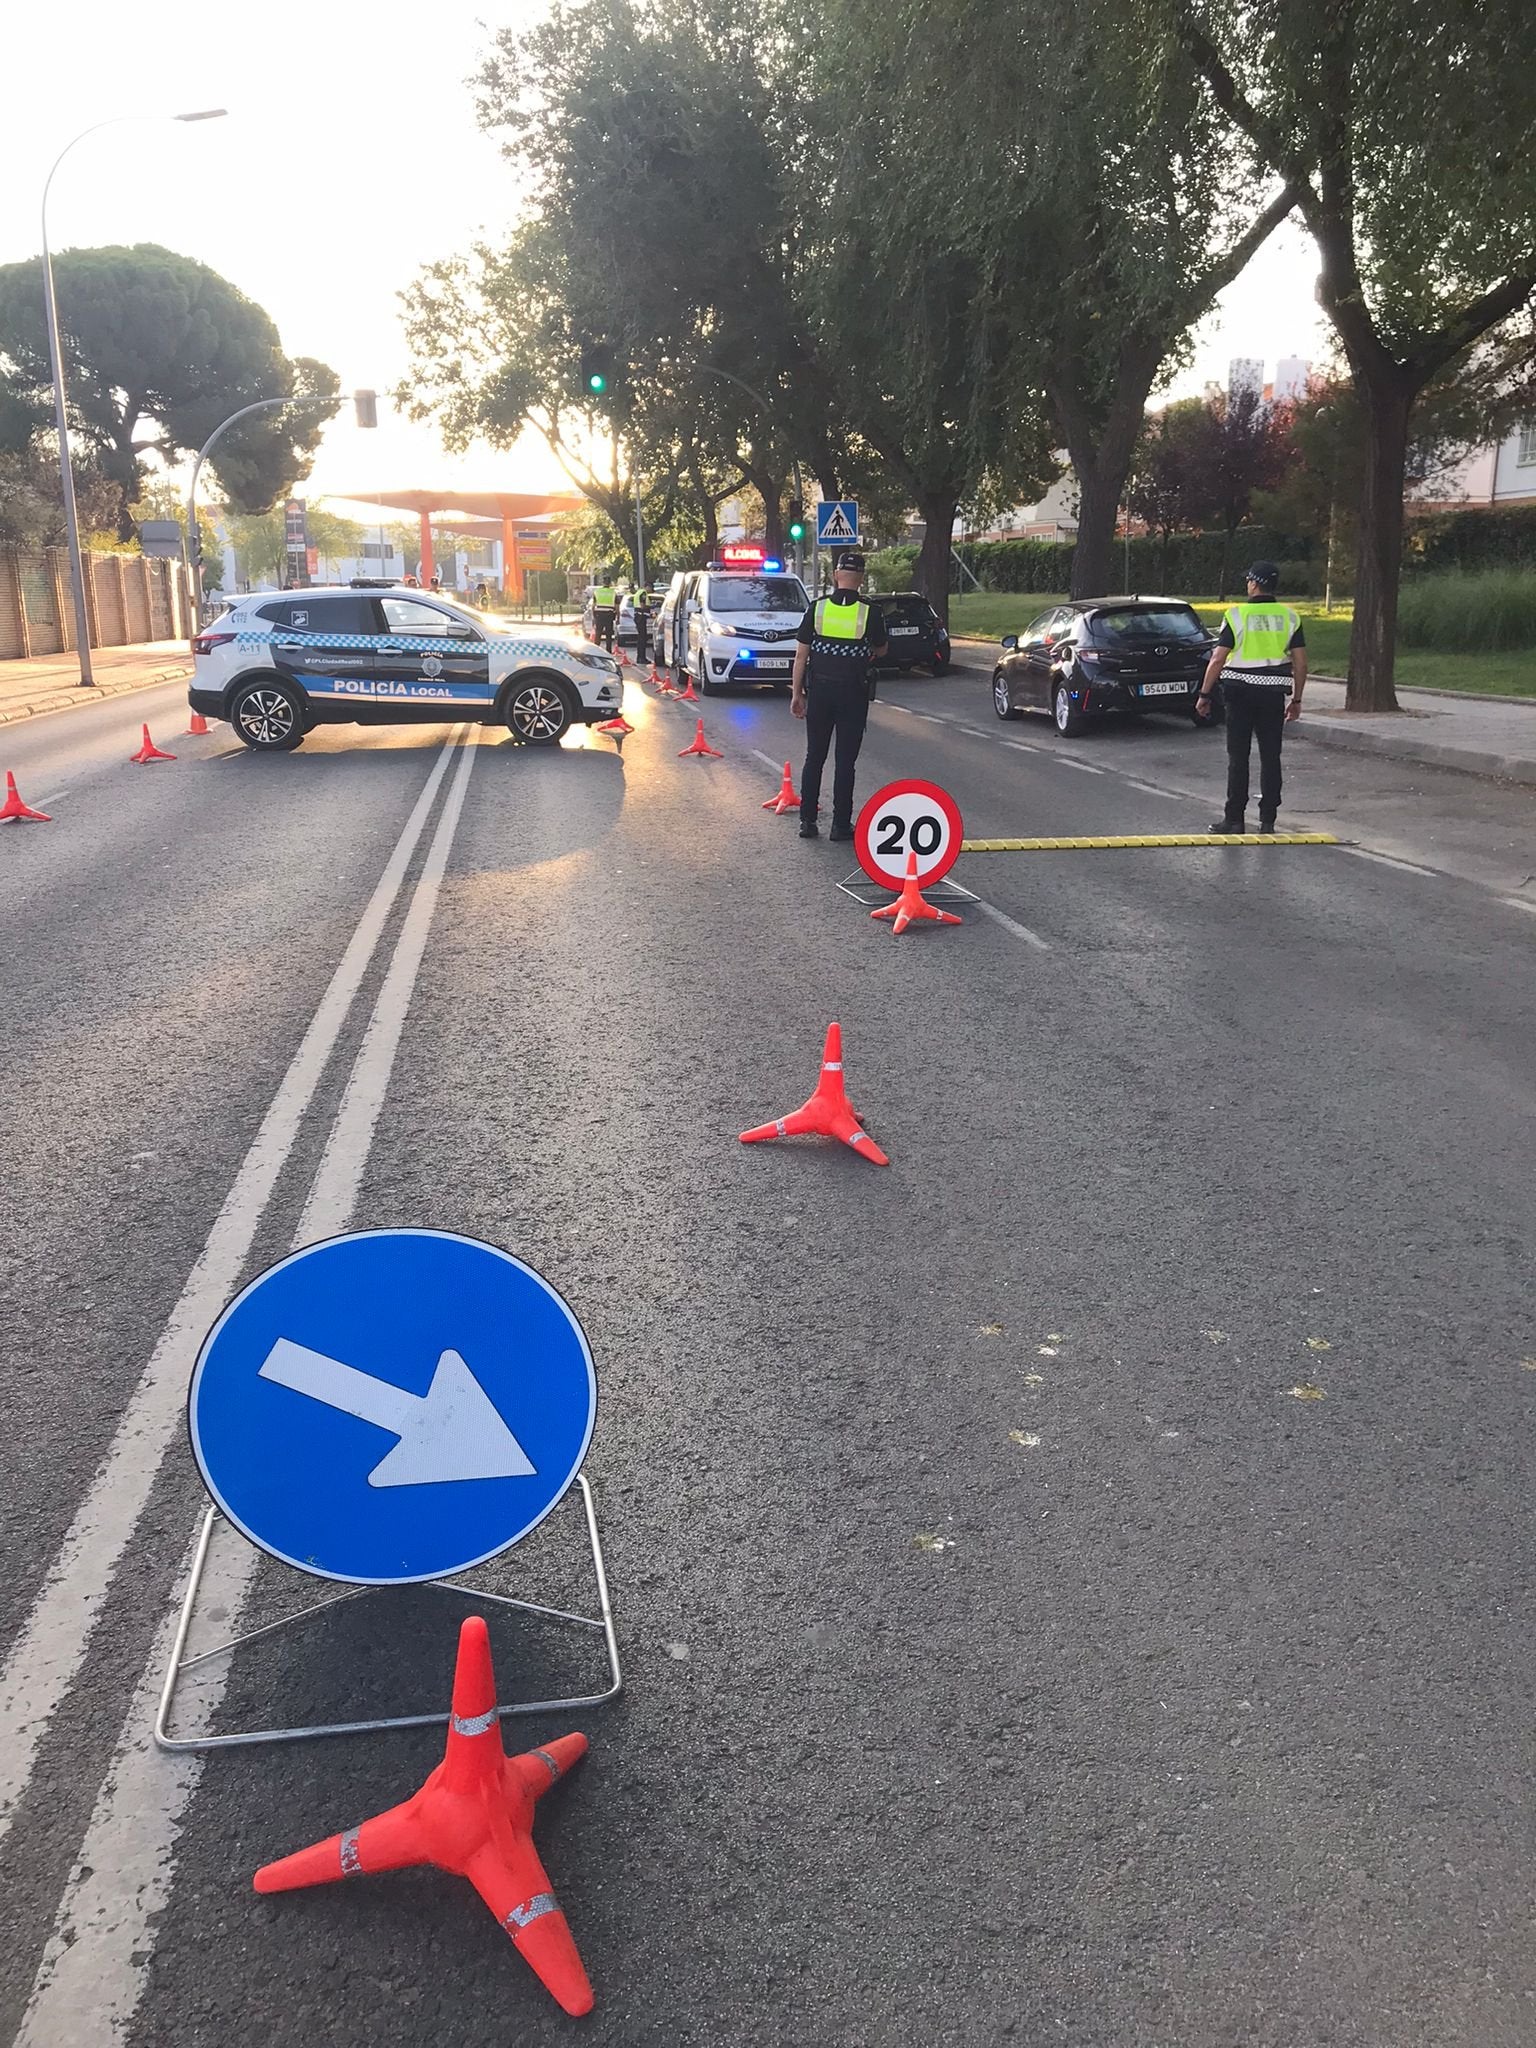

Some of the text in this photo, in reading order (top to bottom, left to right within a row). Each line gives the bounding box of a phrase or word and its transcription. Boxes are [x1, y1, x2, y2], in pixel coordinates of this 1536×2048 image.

[333, 680, 453, 697] POLICÍA LOCAL
[1145, 684, 1167, 694] 9540
[876, 815, 942, 856] 20
